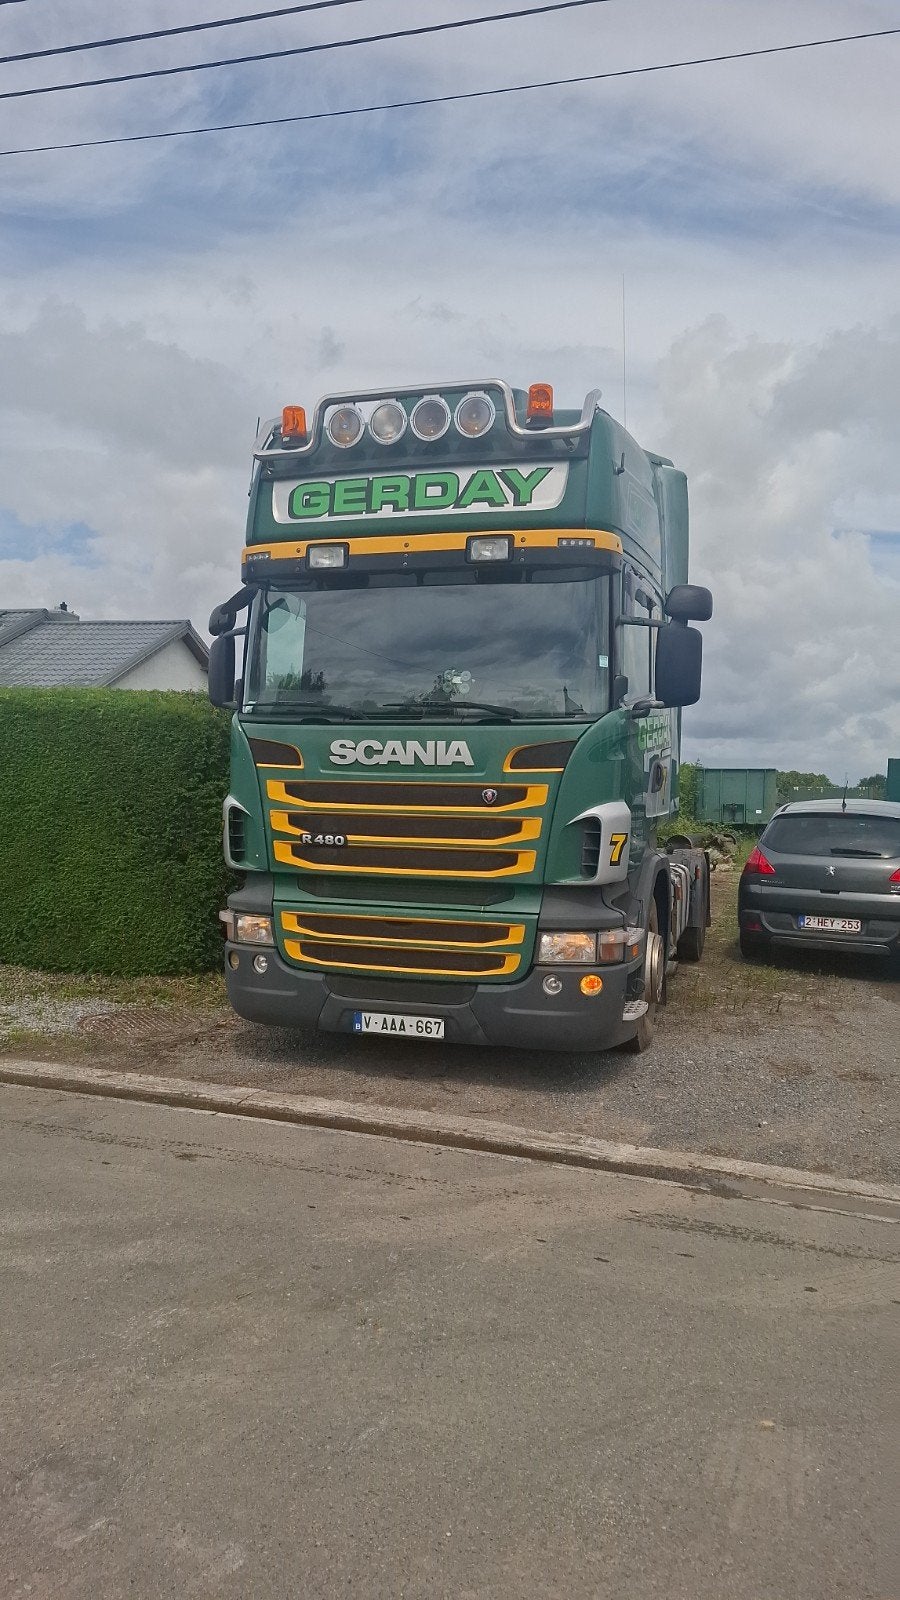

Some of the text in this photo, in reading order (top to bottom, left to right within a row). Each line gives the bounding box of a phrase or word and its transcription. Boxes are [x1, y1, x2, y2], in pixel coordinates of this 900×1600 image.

[288, 467, 554, 519] GERDAY
[328, 739, 475, 766] SCANIA
[302, 834, 345, 846] R 480
[609, 832, 628, 867] 7
[363, 1016, 442, 1035] V-AAA-667
